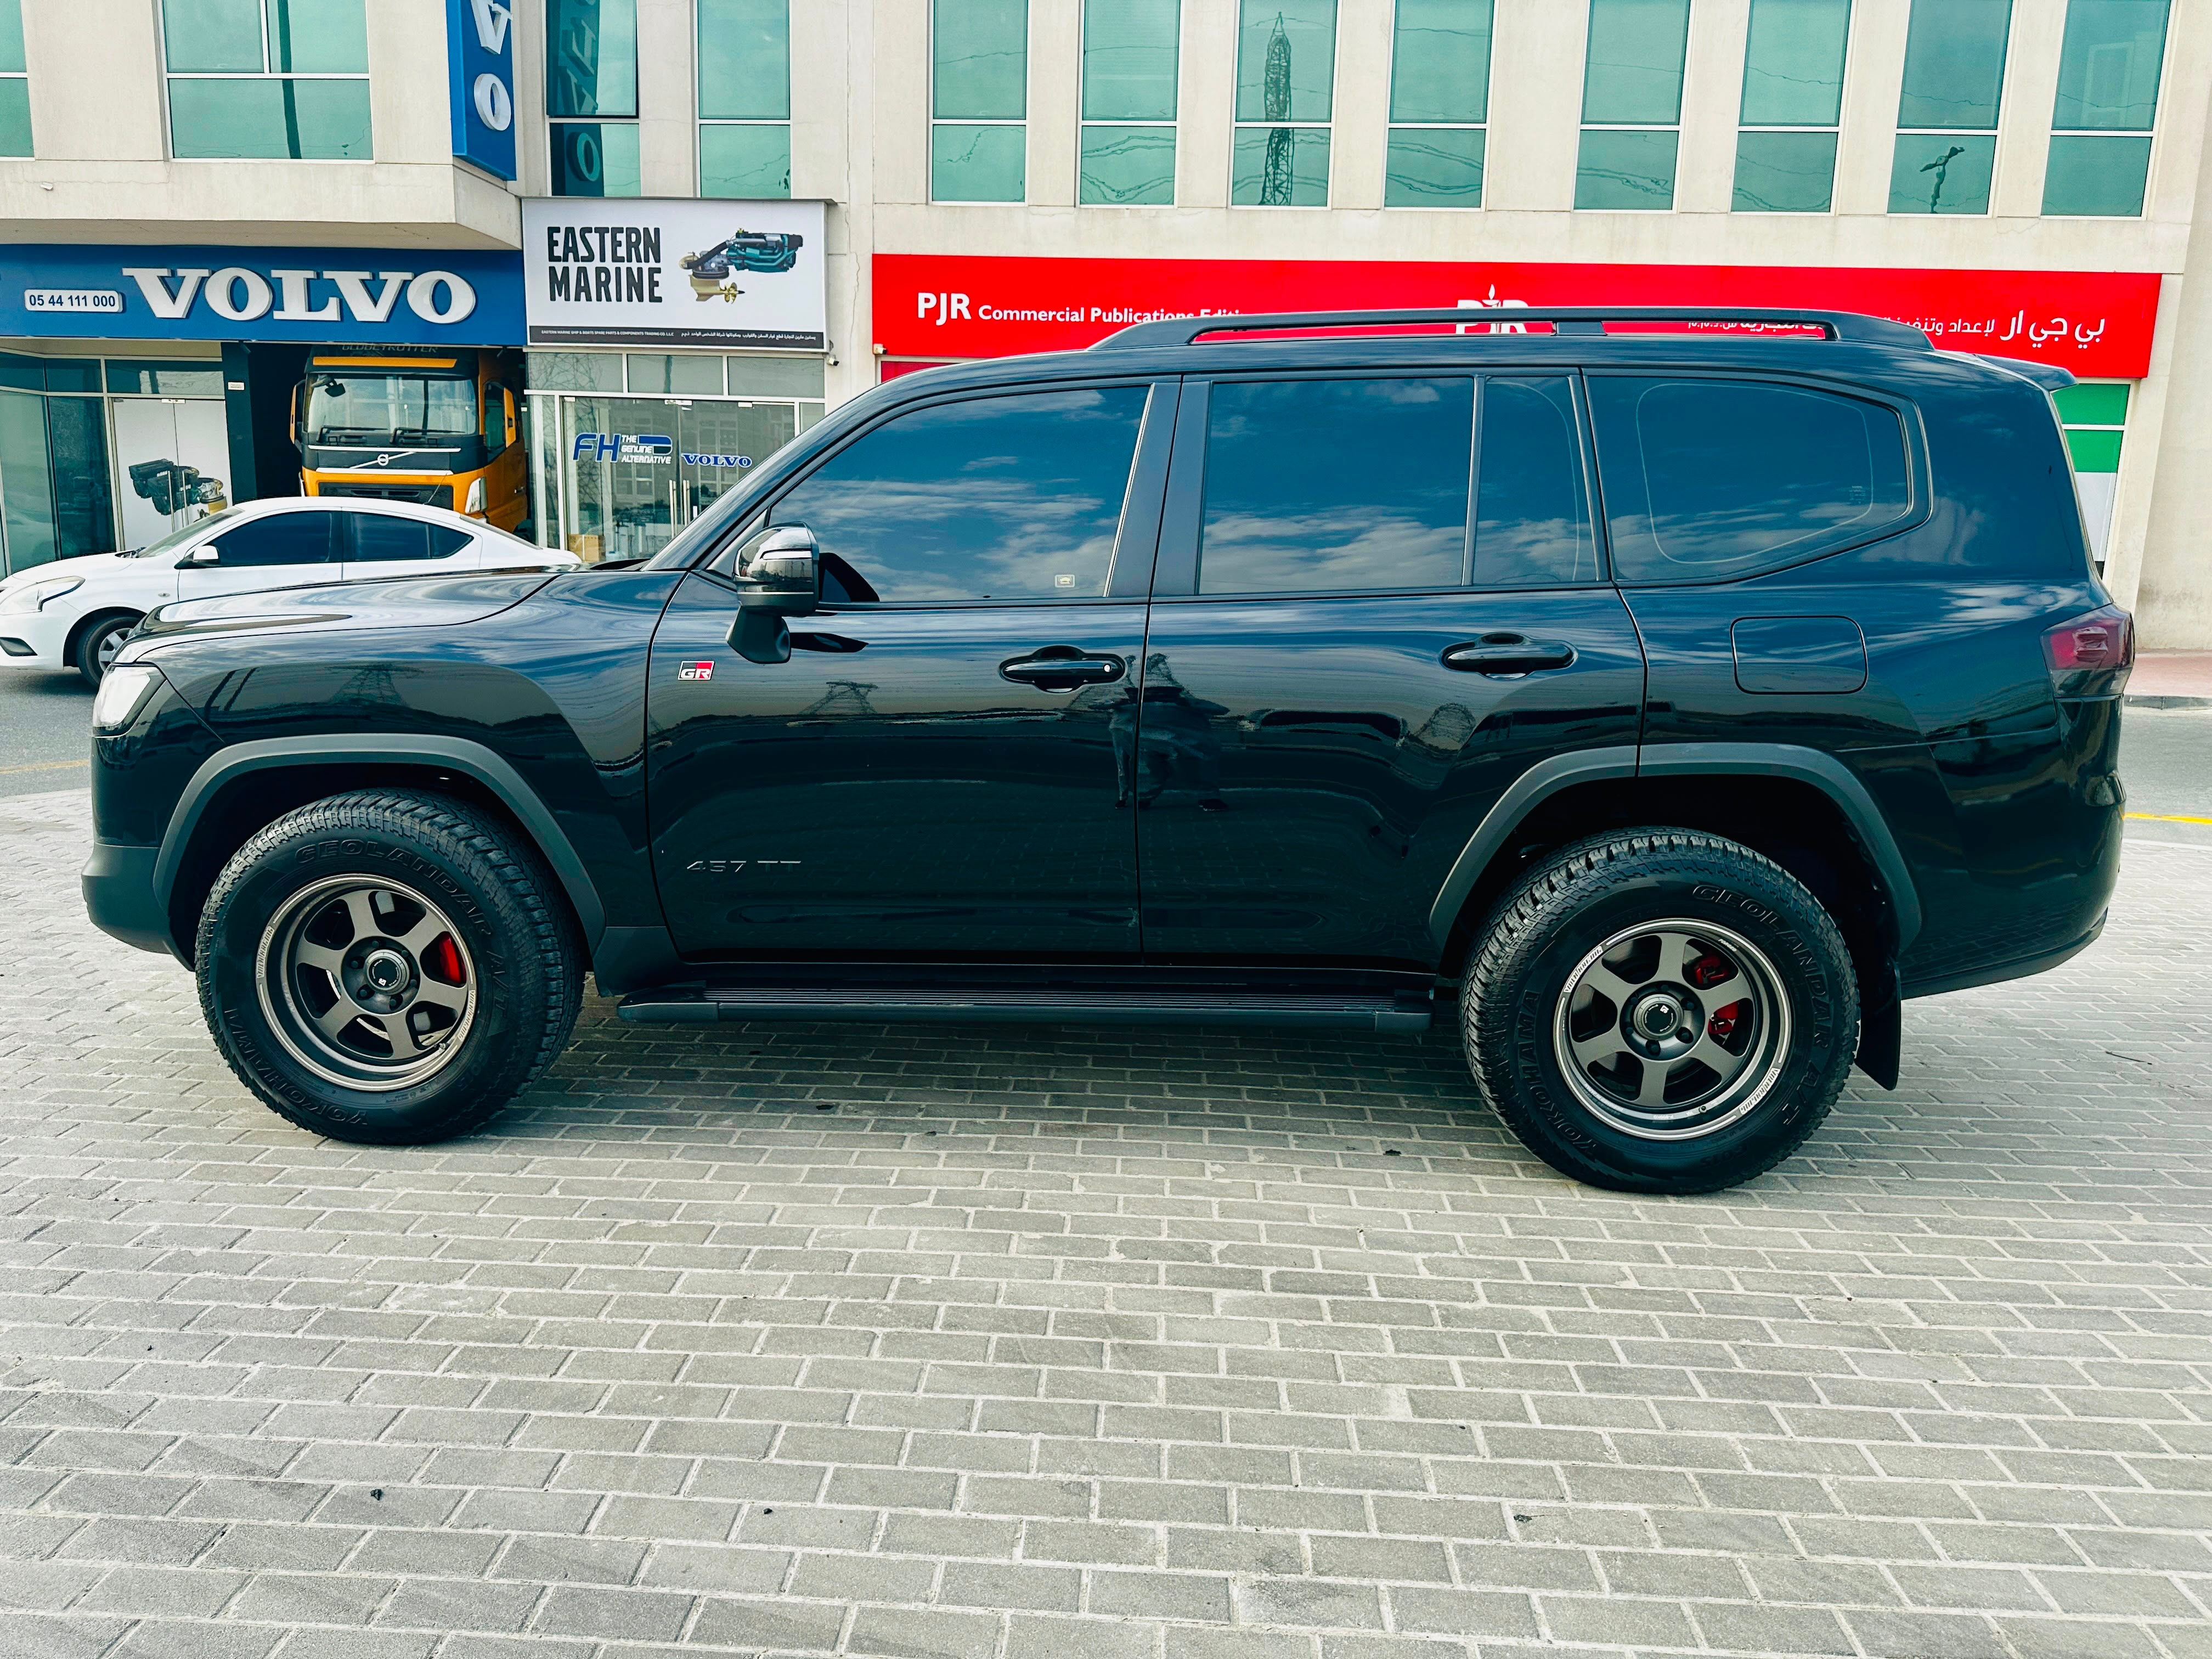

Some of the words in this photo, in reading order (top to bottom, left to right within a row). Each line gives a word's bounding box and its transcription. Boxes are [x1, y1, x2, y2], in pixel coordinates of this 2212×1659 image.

[547, 226, 662, 264] EASTERN
[122, 267, 477, 324] VOLVO
[549, 266, 663, 303] MARINE
[29, 294, 44, 306] 05
[48, 295, 64, 306] 44
[67, 295, 87, 307] 111
[93, 295, 116, 307] 000
[917, 292, 972, 326] PJR
[978, 304, 1085, 322] Commercial
[1948, 318, 1995, 337] لإعداد
[2000, 309, 2024, 341] ار
[2028, 317, 2068, 348] جي
[2074, 317, 2106, 349] بي
[621, 435, 637, 443] THE
[681, 453, 752, 468] VOLVO
[680, 668, 711, 679] GR
